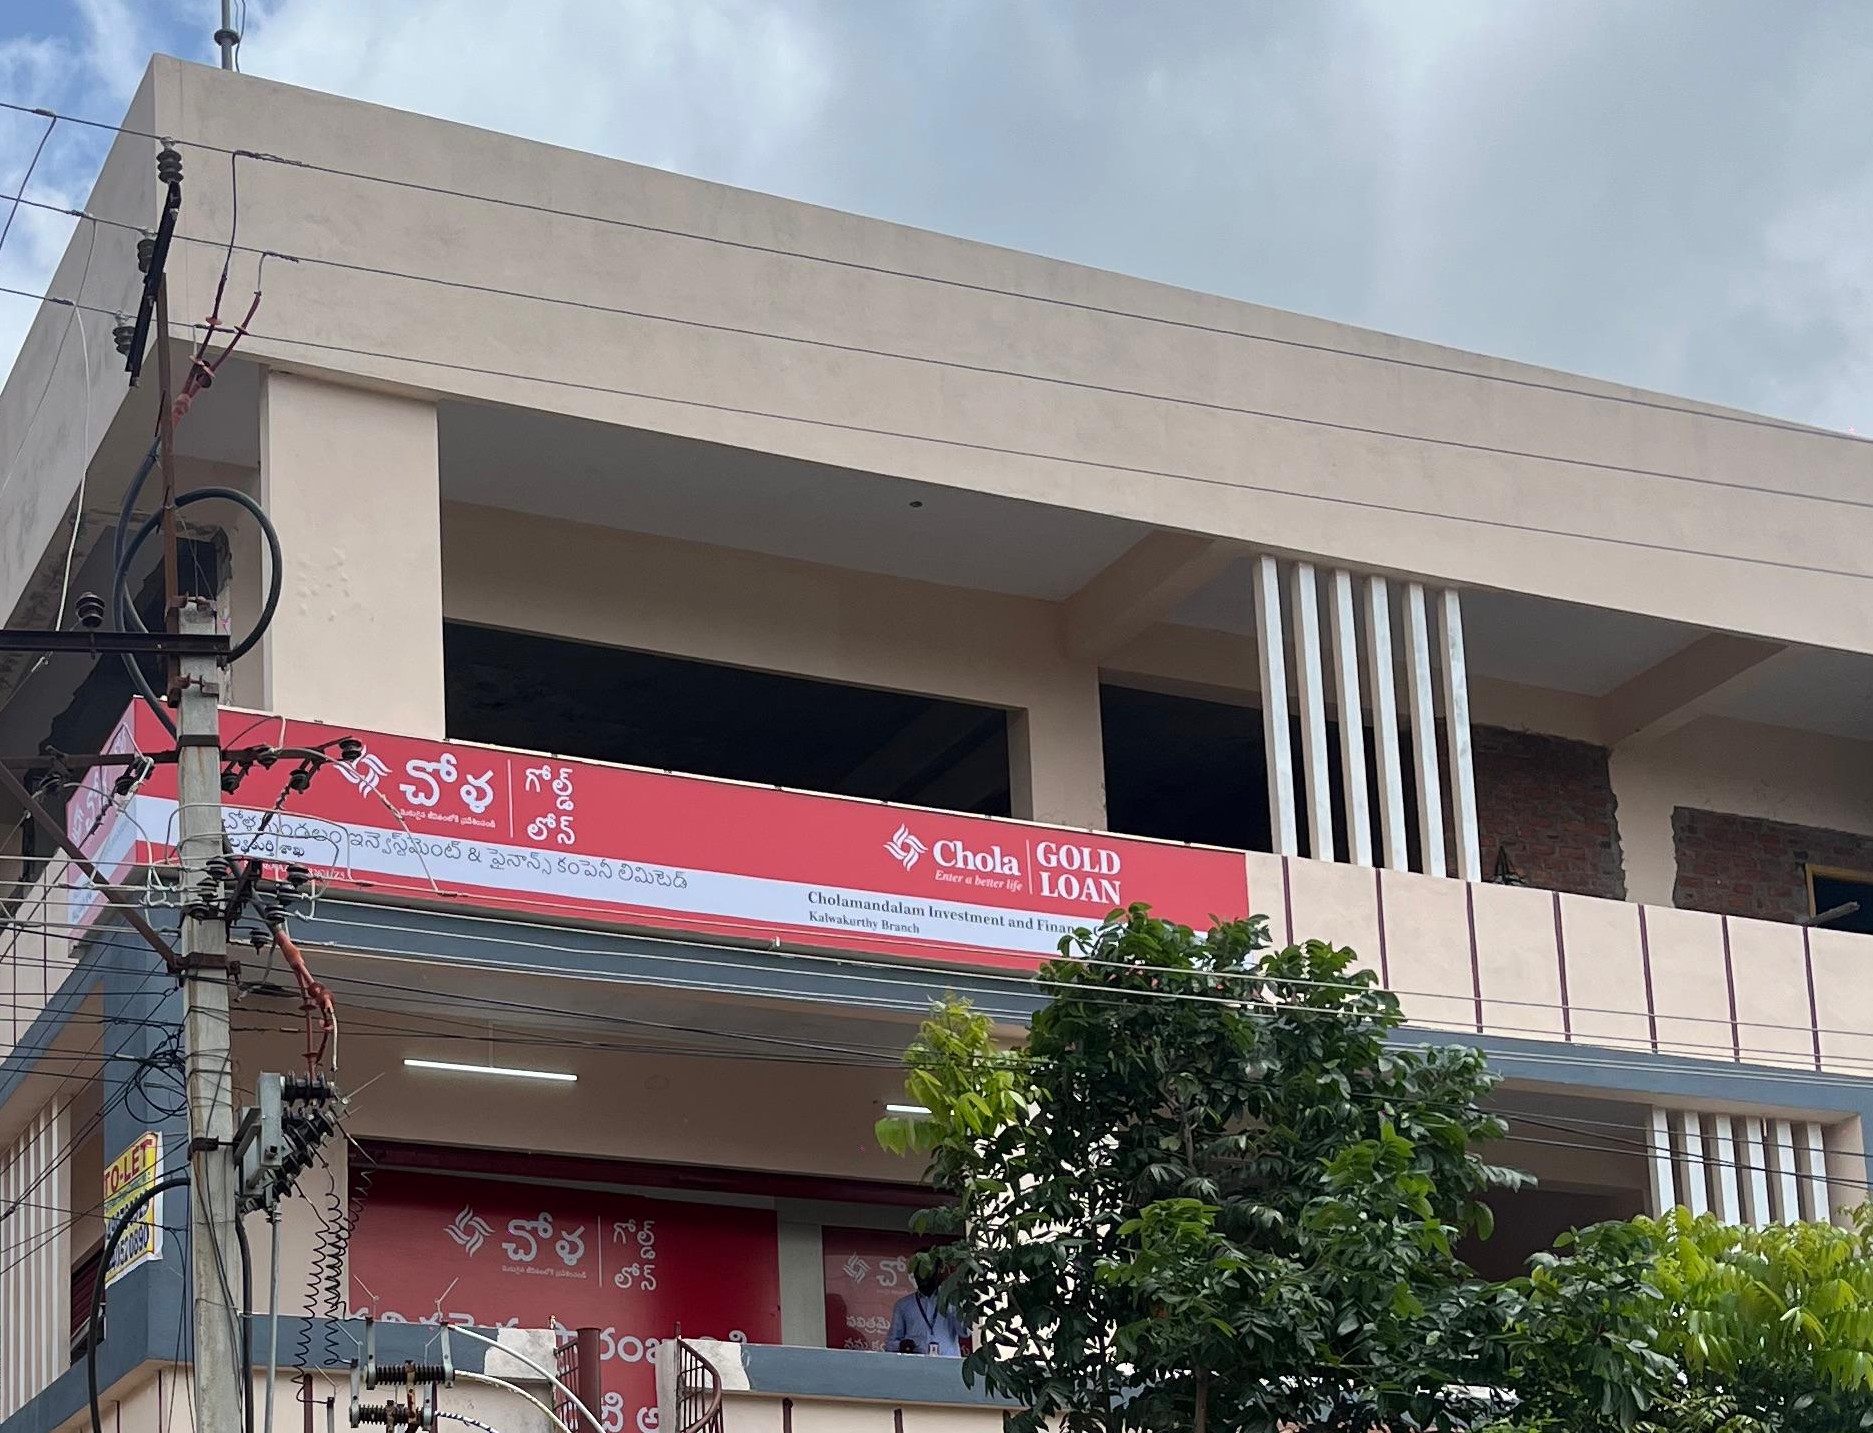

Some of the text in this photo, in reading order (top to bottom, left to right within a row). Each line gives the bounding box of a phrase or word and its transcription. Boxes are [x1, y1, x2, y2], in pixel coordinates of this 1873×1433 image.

[399, 753, 494, 813] చోళ
[525, 765, 575, 811] గోల్డ్
[526, 813, 576, 845] లోన్
[467, 847, 482, 862] &
[557, 857, 613, 880] కంపెనీ
[618, 863, 688, 889] లిమిటెడ్
[933, 839, 1121, 876] Chola GOLD
[935, 869, 962, 884] Enter
[974, 875, 1003, 890] better
[1005, 878, 1023, 892] life
[1039, 871, 1121, 906] LOAN
[808, 890, 925, 918] Cholamandalam
[929, 905, 1005, 928] Investment
[1008, 917, 1034, 931] and
[809, 910, 921, 934] Kalwakurthy Branch
[501, 1211, 586, 1266] చోళ
[612, 1218, 656, 1260] గోల్డ్
[614, 1262, 657, 1291] లోన్
